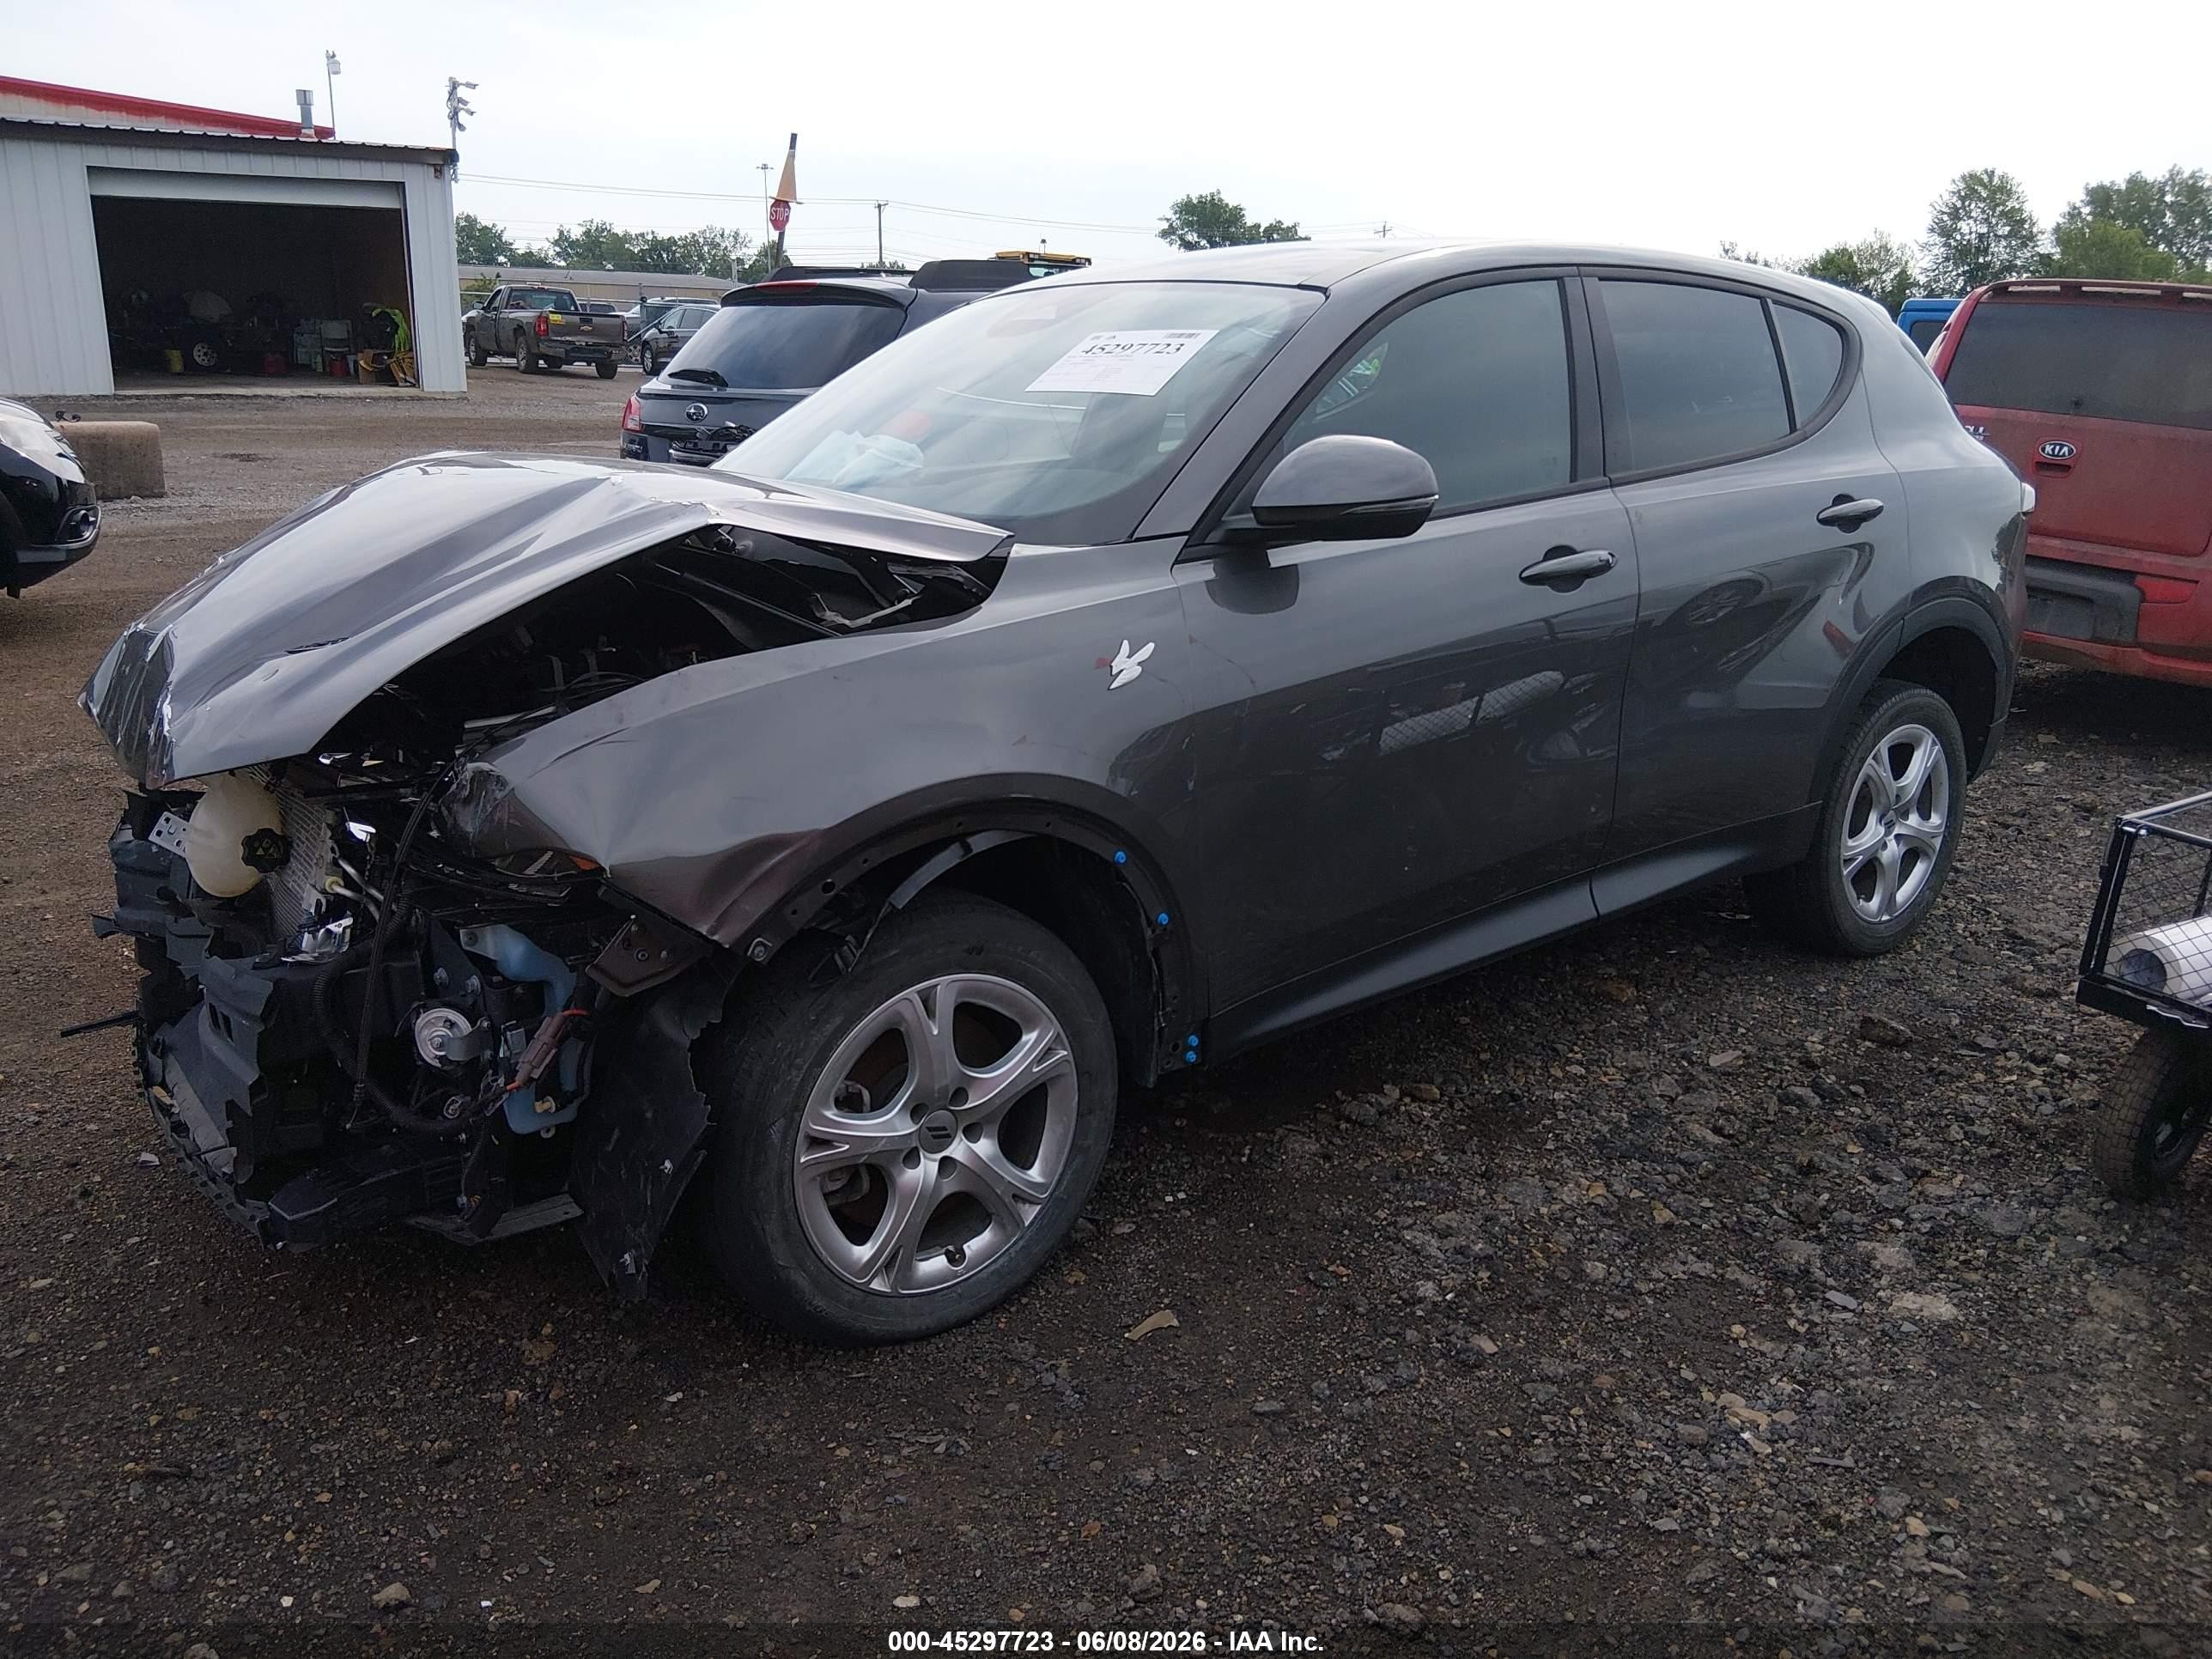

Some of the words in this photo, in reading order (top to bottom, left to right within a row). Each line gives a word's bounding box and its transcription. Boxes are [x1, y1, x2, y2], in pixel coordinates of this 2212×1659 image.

[770, 207, 790, 221] STOP
[1081, 343, 1185, 355] 45297723
[2044, 444, 2069, 457] KIA
